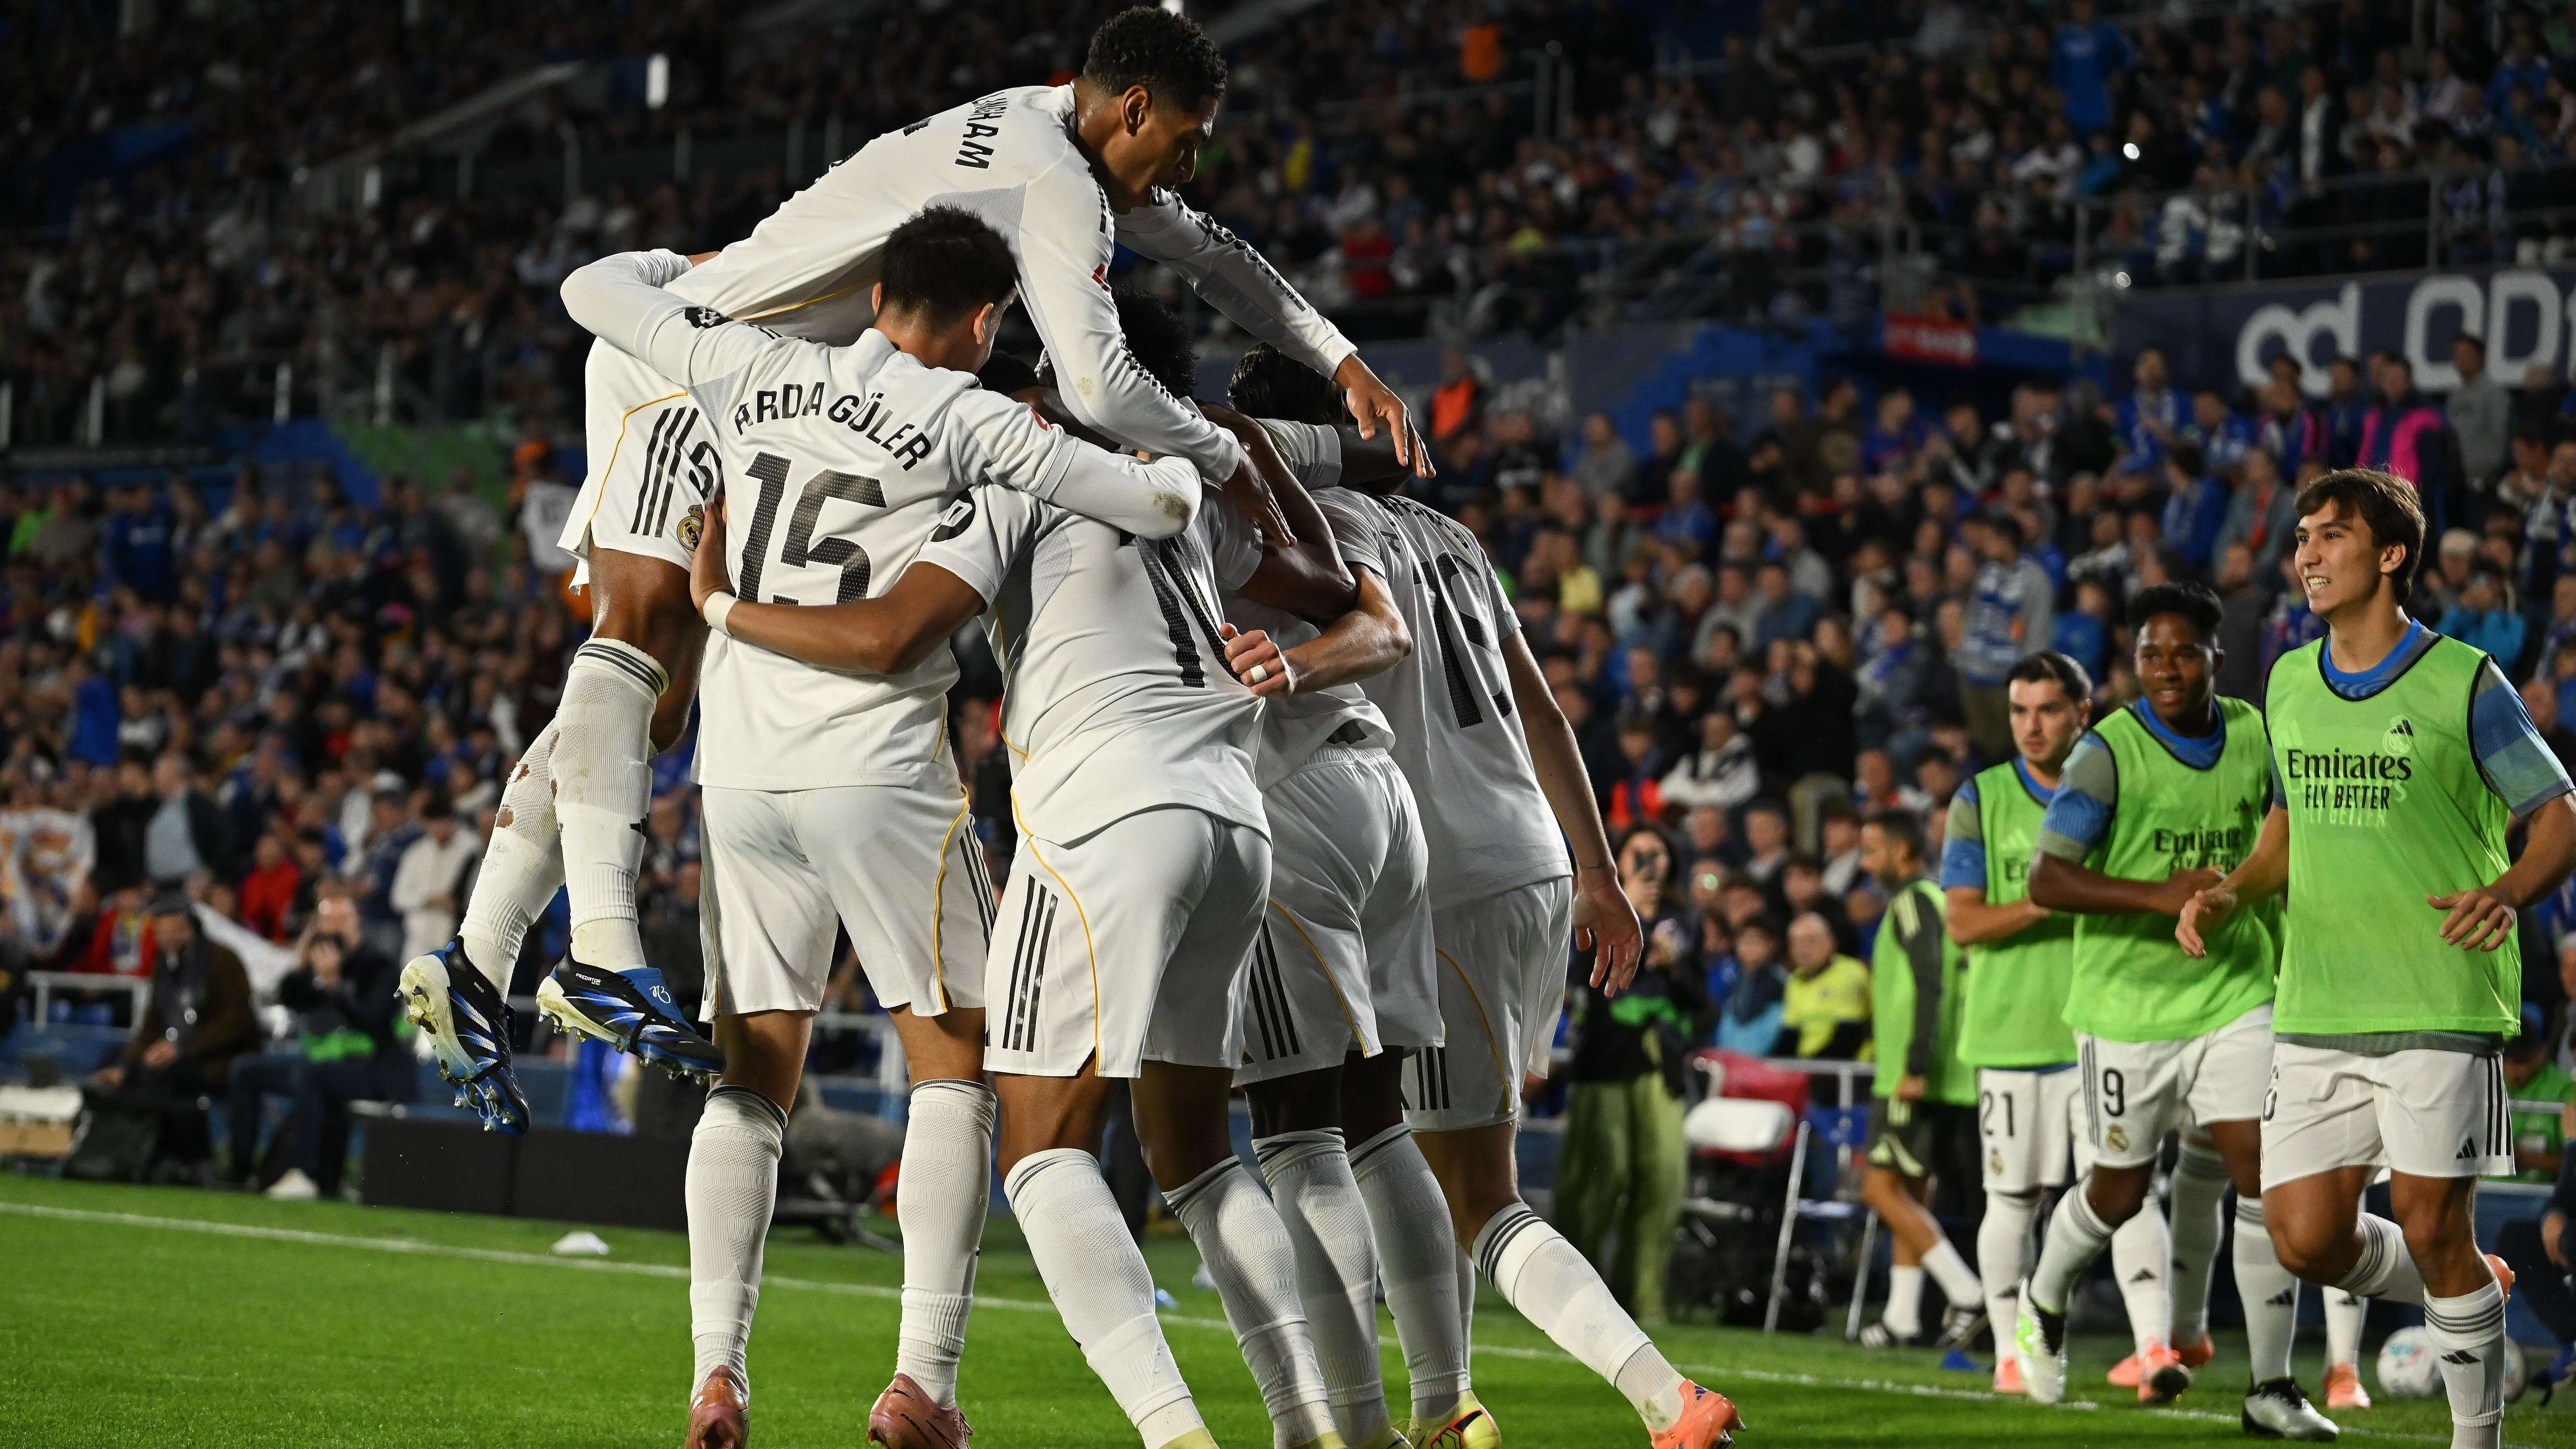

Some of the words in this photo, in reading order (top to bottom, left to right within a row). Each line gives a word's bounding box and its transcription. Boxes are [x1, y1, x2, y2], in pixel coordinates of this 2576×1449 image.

[734, 381, 825, 436] ARDA
[827, 392, 932, 472] GÜLER
[2287, 747, 2413, 781] Emirates
[2305, 784, 2328, 809] FLY
[2333, 784, 2391, 810] BETTER
[575, 973, 601, 984] PREDATOR
[2102, 1068, 2125, 1117] 9
[1980, 1090, 2015, 1137] 21
